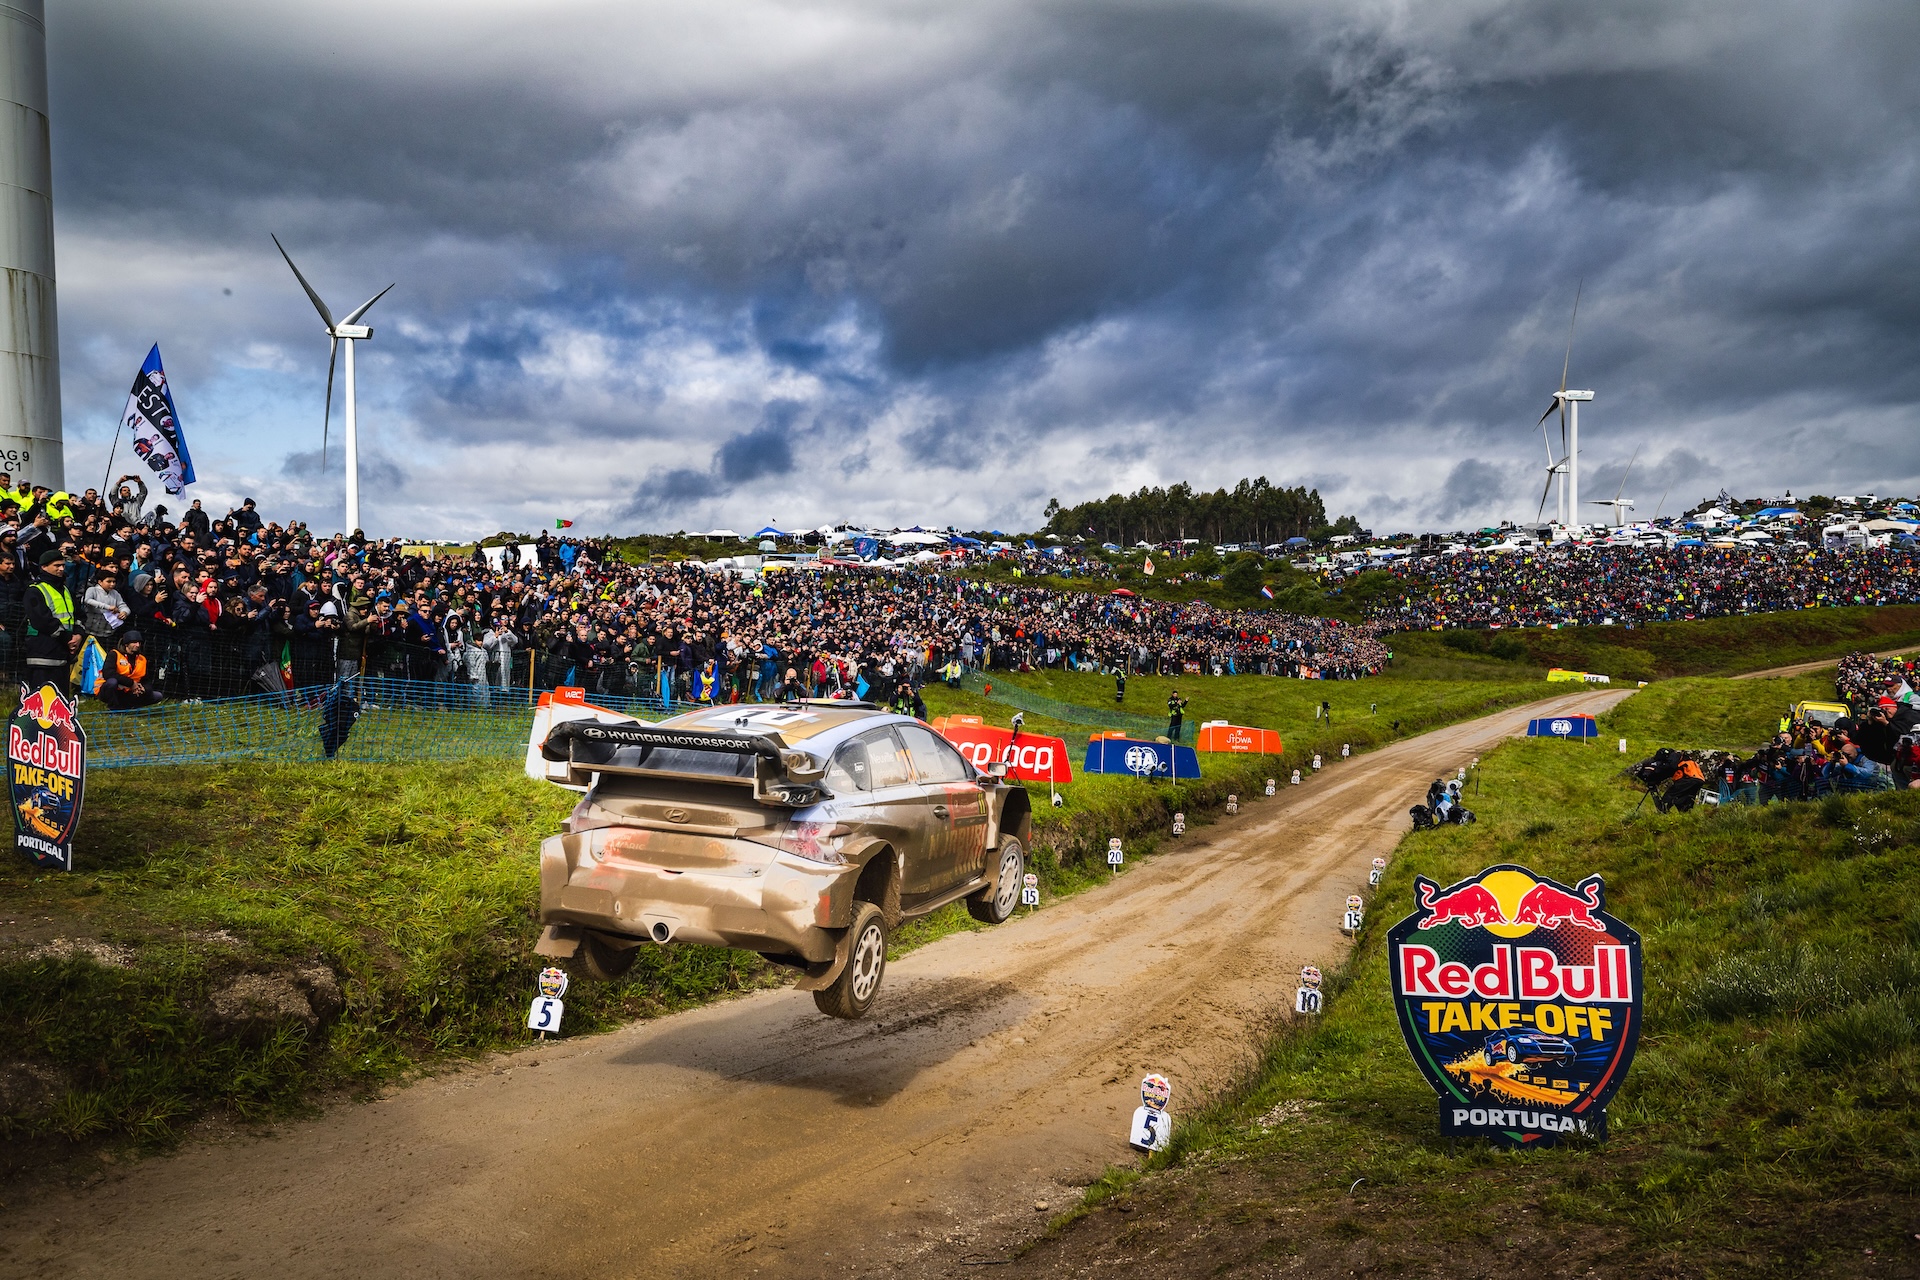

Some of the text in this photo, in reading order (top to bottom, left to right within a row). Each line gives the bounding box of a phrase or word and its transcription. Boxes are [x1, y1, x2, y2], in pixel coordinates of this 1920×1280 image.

[22, 451, 30, 461] 9
[4, 461, 21, 471] C1
[564, 691, 583, 699] WRC
[1552, 722, 1570, 731] FIA
[607, 730, 750, 749] HYUNDAI MOTORSPORT
[1226, 733, 1252, 744] STOWA
[10, 725, 81, 777] Red Bull
[1001, 744, 1052, 774] acp
[1126, 751, 1154, 766] FIA
[14, 763, 74, 801] TAKE-OFF
[1174, 822, 1185, 833] 25
[18, 834, 64, 862] PORTUGAL
[1109, 851, 1121, 863] 20
[1025, 890, 1036, 903] 15
[1347, 913, 1360, 929] 15
[1401, 945, 1631, 1001] Red Bull
[1300, 991, 1318, 1012] 10
[537, 1001, 554, 1028] 5
[1421, 1001, 1613, 1041] TAKE-OFF
[1140, 1114, 1158, 1146] 5
